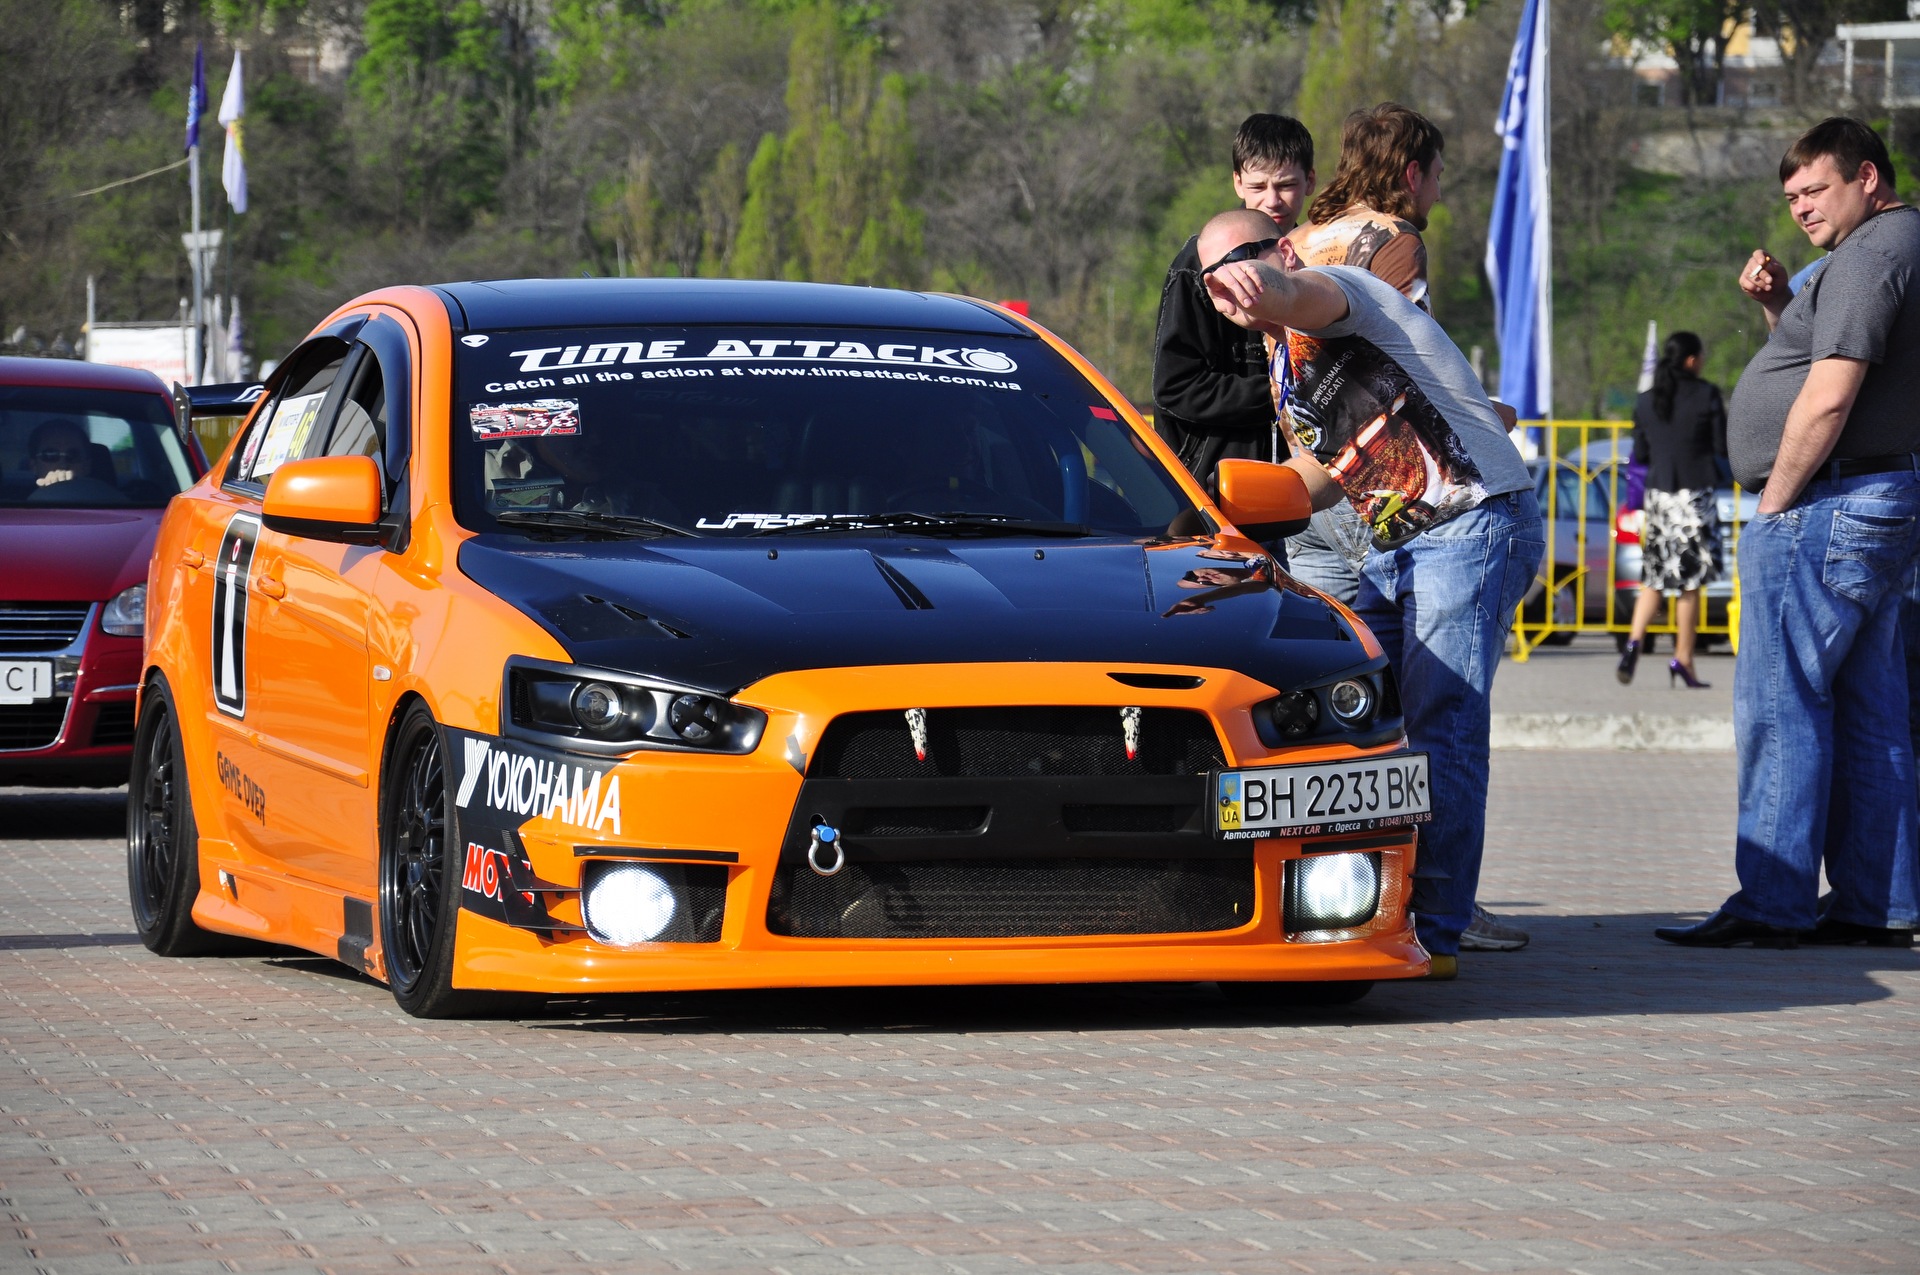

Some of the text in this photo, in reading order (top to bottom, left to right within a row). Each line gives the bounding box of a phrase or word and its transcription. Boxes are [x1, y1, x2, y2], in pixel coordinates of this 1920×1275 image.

[706, 339, 964, 366] ATTACK
[485, 366, 1022, 393] Catch all the action at www.timeattack.com.ua
[1320, 376, 1346, 406] DUCATI
[217, 751, 265, 826] GAME OVER
[487, 748, 622, 836] YOKOHAMA
[1243, 765, 1422, 823] BH 2233 BK
[1221, 810, 1240, 824] UA
[1222, 830, 1271, 841] Автосалон
[1279, 826, 1303, 837] NEXT
[1304, 825, 1321, 835] CAR
[1335, 821, 1361, 833] Одесса
[1402, 814, 1414, 825] 703
[1415, 813, 1424, 823] 58
[1424, 812, 1433, 822] 58
